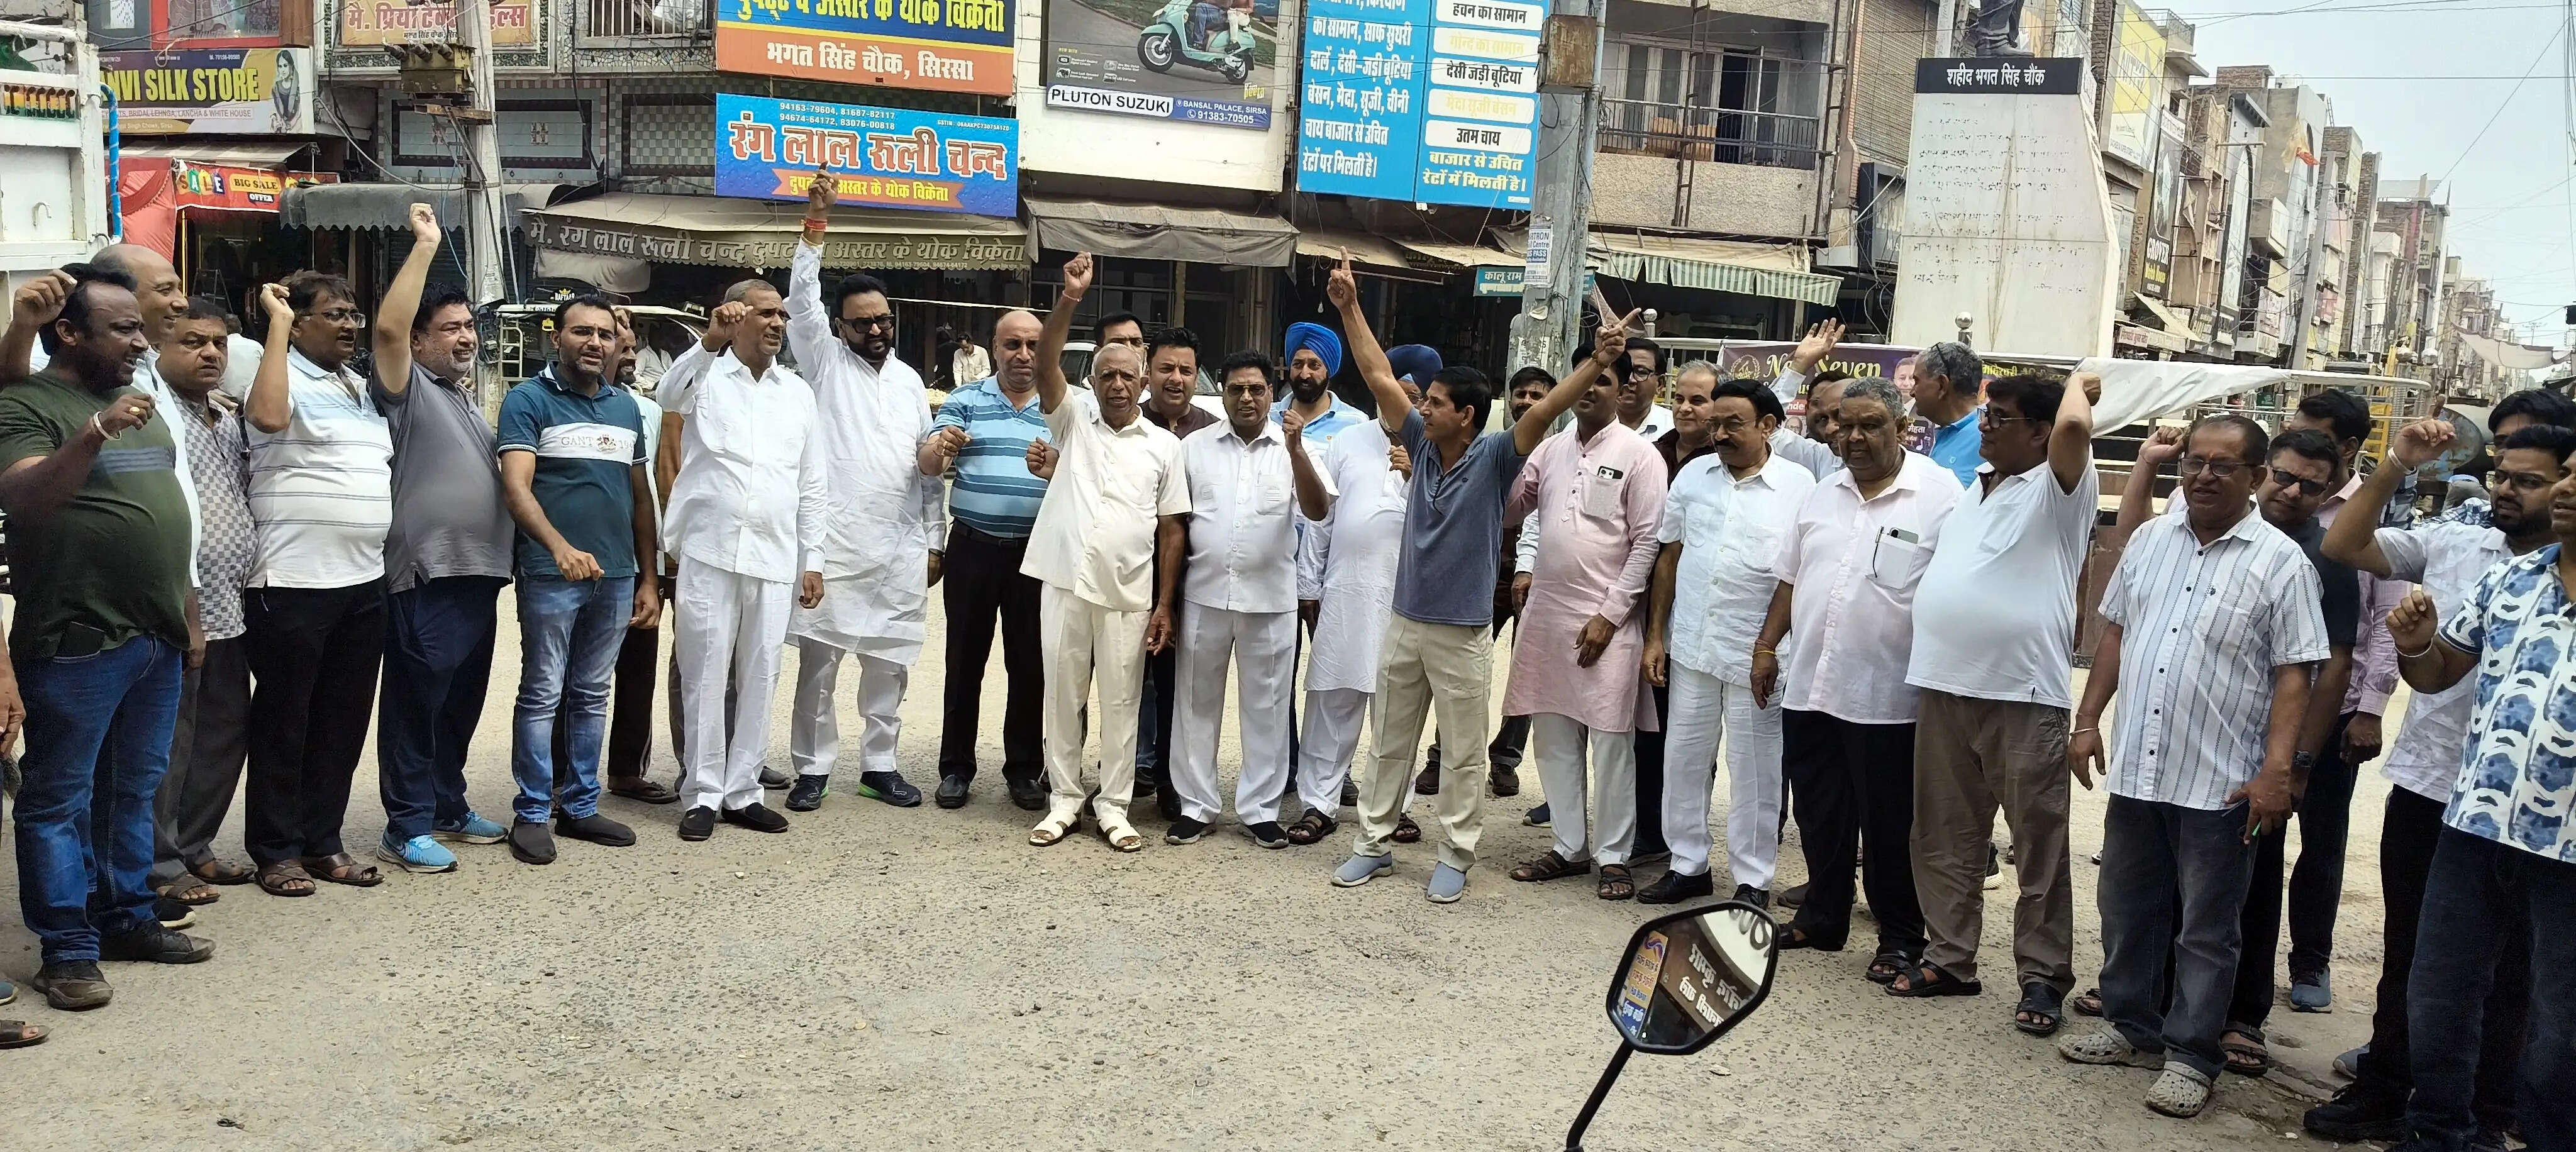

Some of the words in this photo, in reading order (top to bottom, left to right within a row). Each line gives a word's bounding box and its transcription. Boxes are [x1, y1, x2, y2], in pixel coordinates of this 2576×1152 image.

[1453, 3, 1475, 18] हवन
[1478, 6, 1492, 19] का
[1494, 8, 1527, 23] सामान
[1313, 16, 1328, 36] का
[1328, 19, 1362, 45] सामान,
[1364, 23, 1385, 43] साफ
[1385, 21, 1412, 52] सुथरी
[767, 42, 813, 67] भगत
[819, 42, 856, 71] सिंह
[862, 45, 910, 79] चौक,
[918, 50, 974, 81] सिरसा
[100, 69, 142, 102] NVI
[144, 68, 189, 101] SILK
[192, 67, 260, 101] STORE
[1446, 60, 1467, 79] देसी
[1468, 64, 1491, 85] जड़ी
[1491, 65, 1524, 87] बूटियां
[1947, 62, 1974, 86] शहीद
[1975, 68, 1999, 86] भगत
[2001, 63, 2020, 87] सिंह
[2024, 62, 2046, 86] चौंक
[779, 102, 839, 116] 94163-79604,
[840, 108, 896, 119] 81687-82117
[1052, 88, 1113, 107] PLUTON
[1116, 96, 1171, 114] SUZUKI
[1182, 100, 1210, 111] BANSAL
[1213, 102, 1245, 114] PALACE,
[1246, 106, 1268, 115] SIRSA
[1387, 87, 1410, 114] चीनी
[177, 109, 203, 118] LANCHA
[209, 109, 228, 117] WHITE
[230, 109, 251, 118] HOUSE
[779, 113, 838, 126] 94674-64172,
[840, 118, 896, 130] 83076-00818
[1197, 110, 1255, 124] 91383-70505
[1305, 119, 1324, 139] चाय
[1325, 121, 1353, 142] बाजार
[1355, 118, 1363, 143] से
[1364, 120, 1389, 145] उचित
[1457, 128, 1479, 144] उतम
[1481, 130, 1501, 146] चाय
[730, 113, 774, 160] रंग
[784, 128, 860, 169] लाल
[868, 129, 939, 175] रूली
[948, 140, 1006, 179] चन्द
[1302, 146, 1319, 172] रेटों
[1320, 153, 1333, 174] पर
[1333, 150, 1365, 177] मिलती
[1429, 151, 1472, 167] बाजार
[1474, 152, 1487, 168] से
[1488, 153, 1524, 172] उचित
[179, 168, 226, 194] SALE
[234, 178, 250, 187] BIG
[253, 179, 278, 190] SALE
[1423, 168, 1448, 185] रेटों
[1448, 170, 1463, 187] में
[1462, 171, 1509, 191] मिलती
[249, 192, 274, 202] OFFER
[837, 180, 867, 194] अस्तर
[870, 180, 882, 196] के
[886, 181, 911, 199] थोक
[913, 185, 949, 202] विक्रेता
[530, 220, 552, 245] मै.
[560, 218, 589, 248] रंग
[593, 229, 636, 254] लाल
[640, 228, 694, 261] रूली
[699, 238, 752, 265] चन्द
[833, 240, 887, 261] अस्तर
[892, 234, 914, 260] के
[916, 235, 961, 262] थोक
[962, 235, 1026, 265] विक्रेता
[1485, 271, 1506, 284] कालू
[1507, 272, 1523, 281] राम
[561, 436, 593, 447] GANT
